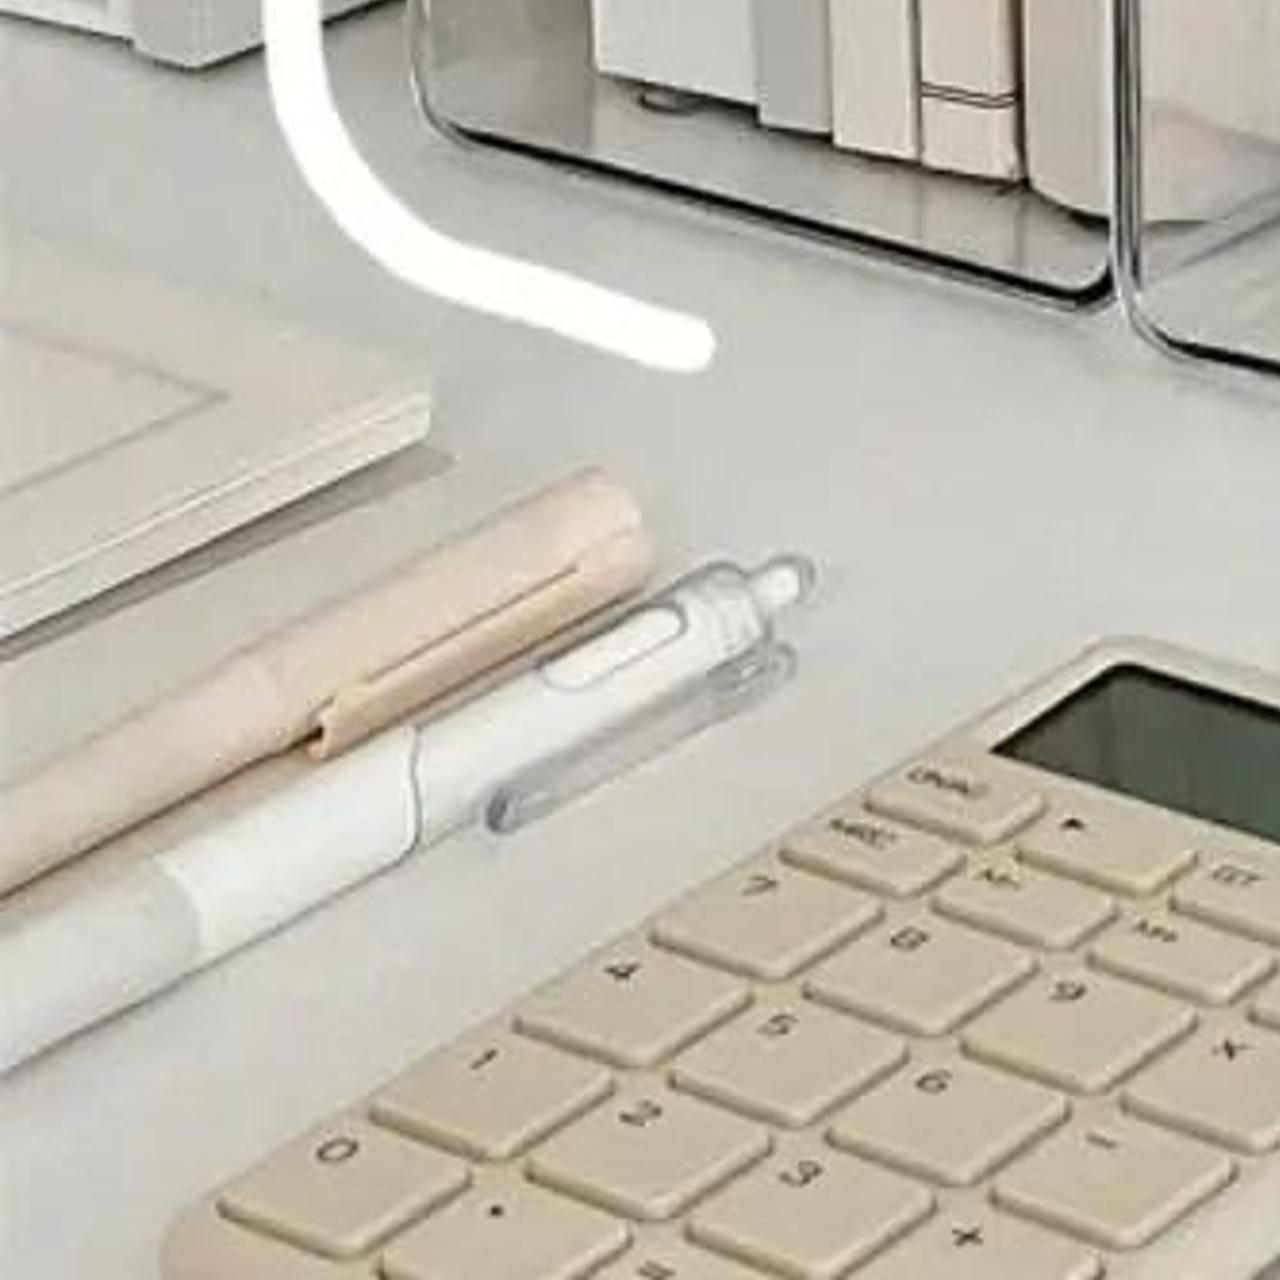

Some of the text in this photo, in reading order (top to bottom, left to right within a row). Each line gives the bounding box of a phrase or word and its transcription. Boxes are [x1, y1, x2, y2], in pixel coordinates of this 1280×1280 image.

[604, 962, 642, 981] 4
[756, 1012, 797, 1038] 5
[472, 1048, 498, 1069] 1
[914, 1069, 952, 1093] 6
[316, 1138, 359, 1162] 0
[779, 1159, 823, 1187] 3
